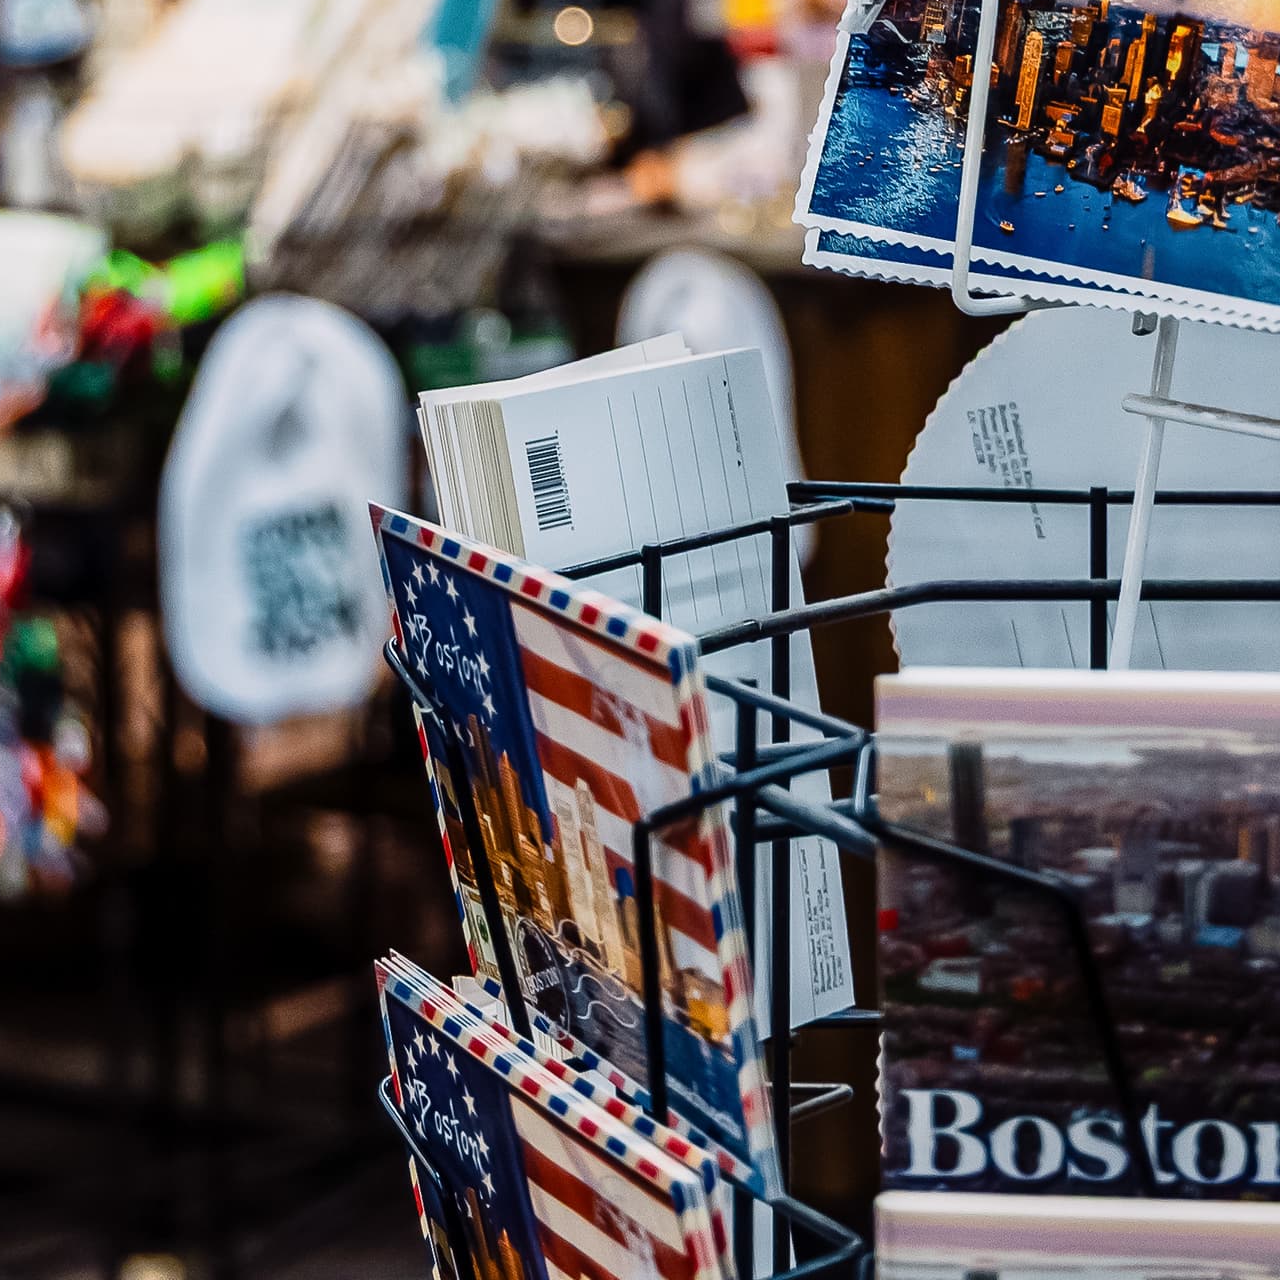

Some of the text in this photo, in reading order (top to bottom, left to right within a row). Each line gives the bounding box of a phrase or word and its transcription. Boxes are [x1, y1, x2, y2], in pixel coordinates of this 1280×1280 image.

[414, 614, 486, 697] Boston
[525, 966, 561, 995] BOSTON
[414, 1078, 486, 1177] Boston
